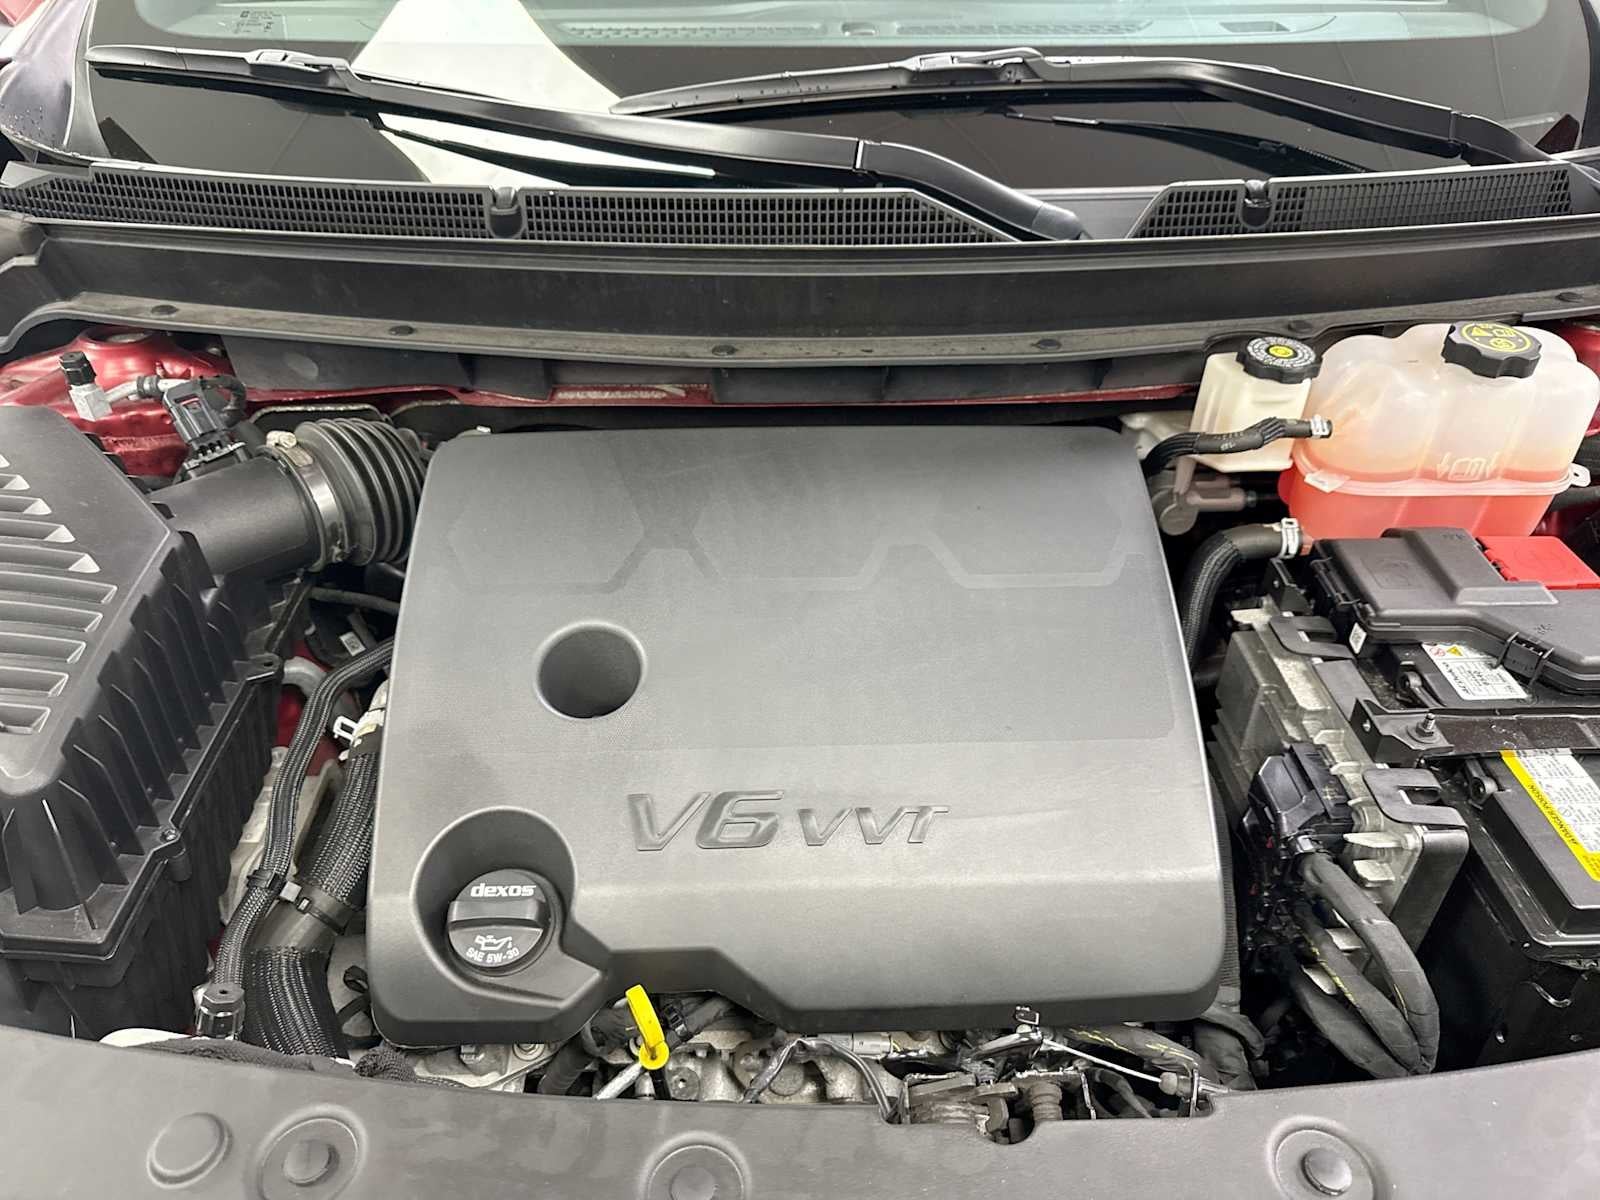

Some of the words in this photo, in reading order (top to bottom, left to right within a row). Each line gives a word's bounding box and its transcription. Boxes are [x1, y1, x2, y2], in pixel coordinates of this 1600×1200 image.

[627, 790, 784, 851] V6
[797, 805, 950, 847] VVT
[470, 882, 537, 898] dexos
[466, 947, 485, 962] SAE
[486, 947, 520, 964] 5W-30
